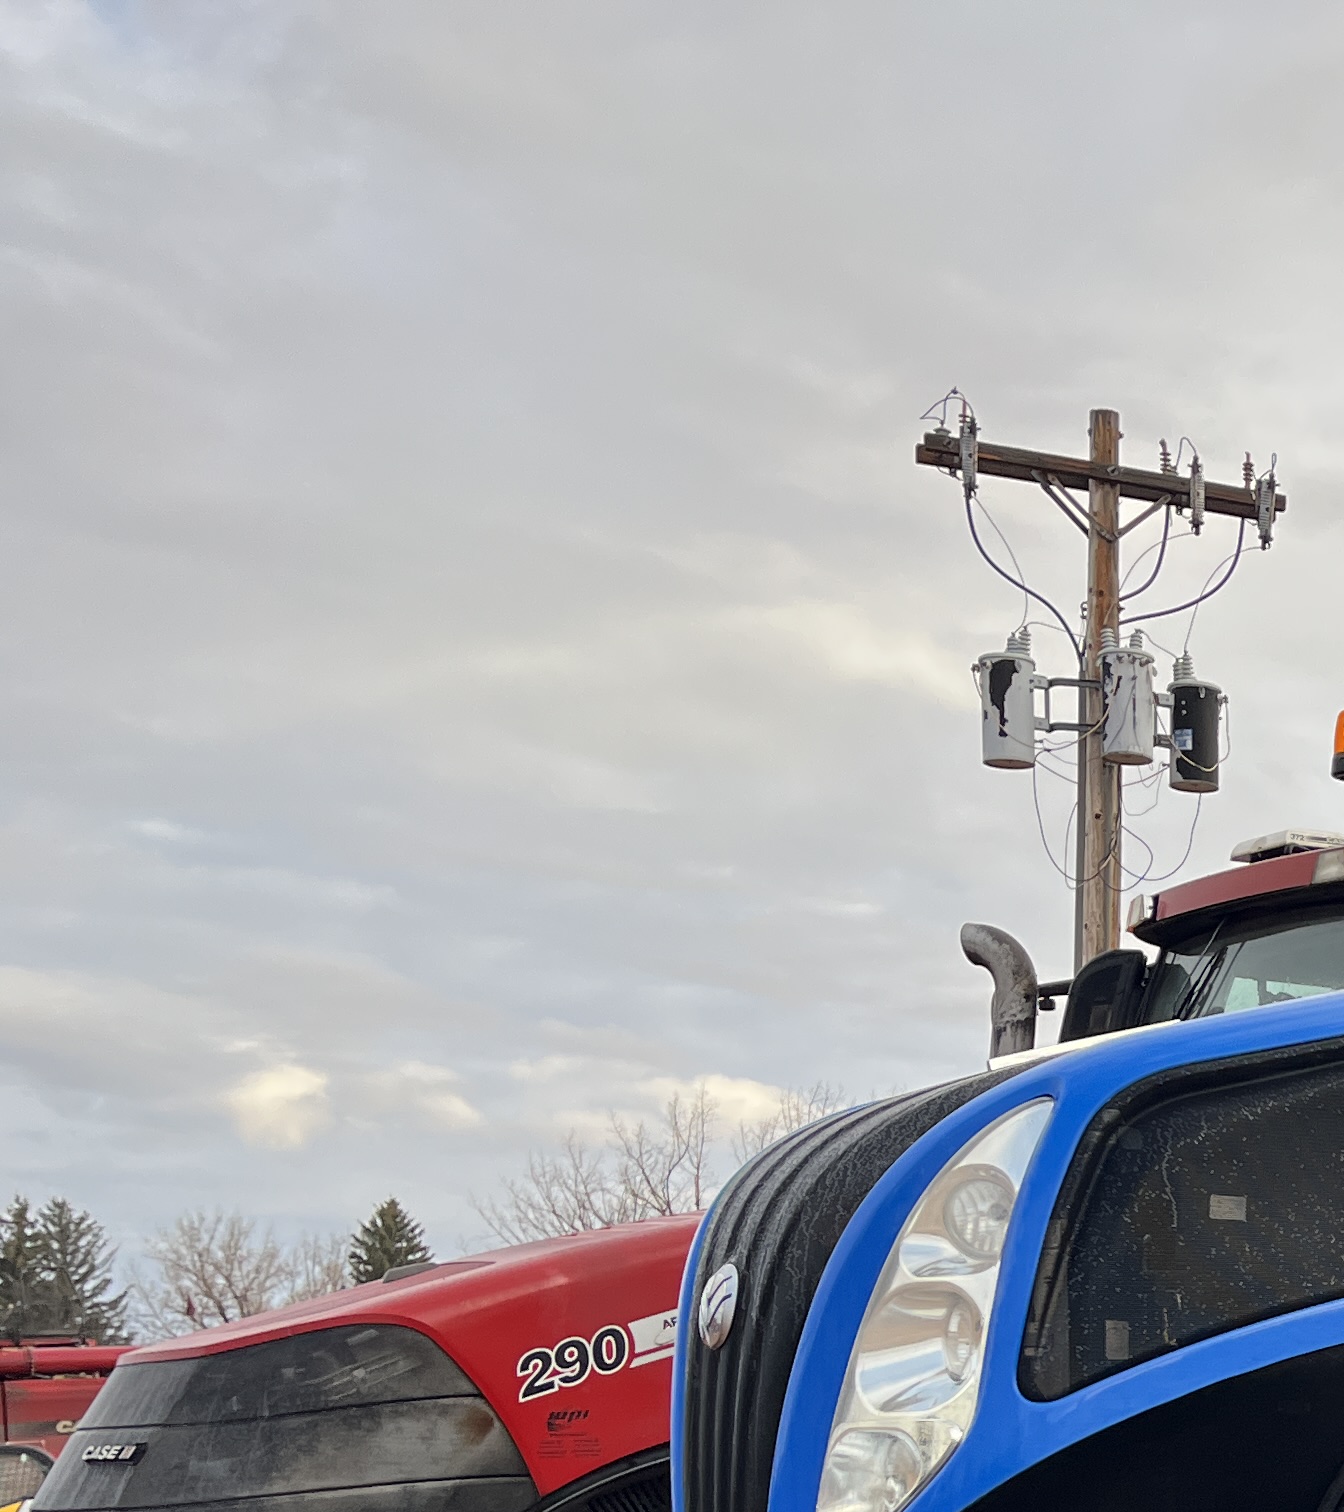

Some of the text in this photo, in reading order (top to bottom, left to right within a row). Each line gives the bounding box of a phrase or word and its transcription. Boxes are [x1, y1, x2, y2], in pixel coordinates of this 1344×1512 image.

[662, 1317, 678, 1330] AF
[516, 1325, 629, 1403] 290
[82, 1445, 120, 1460] CASE
